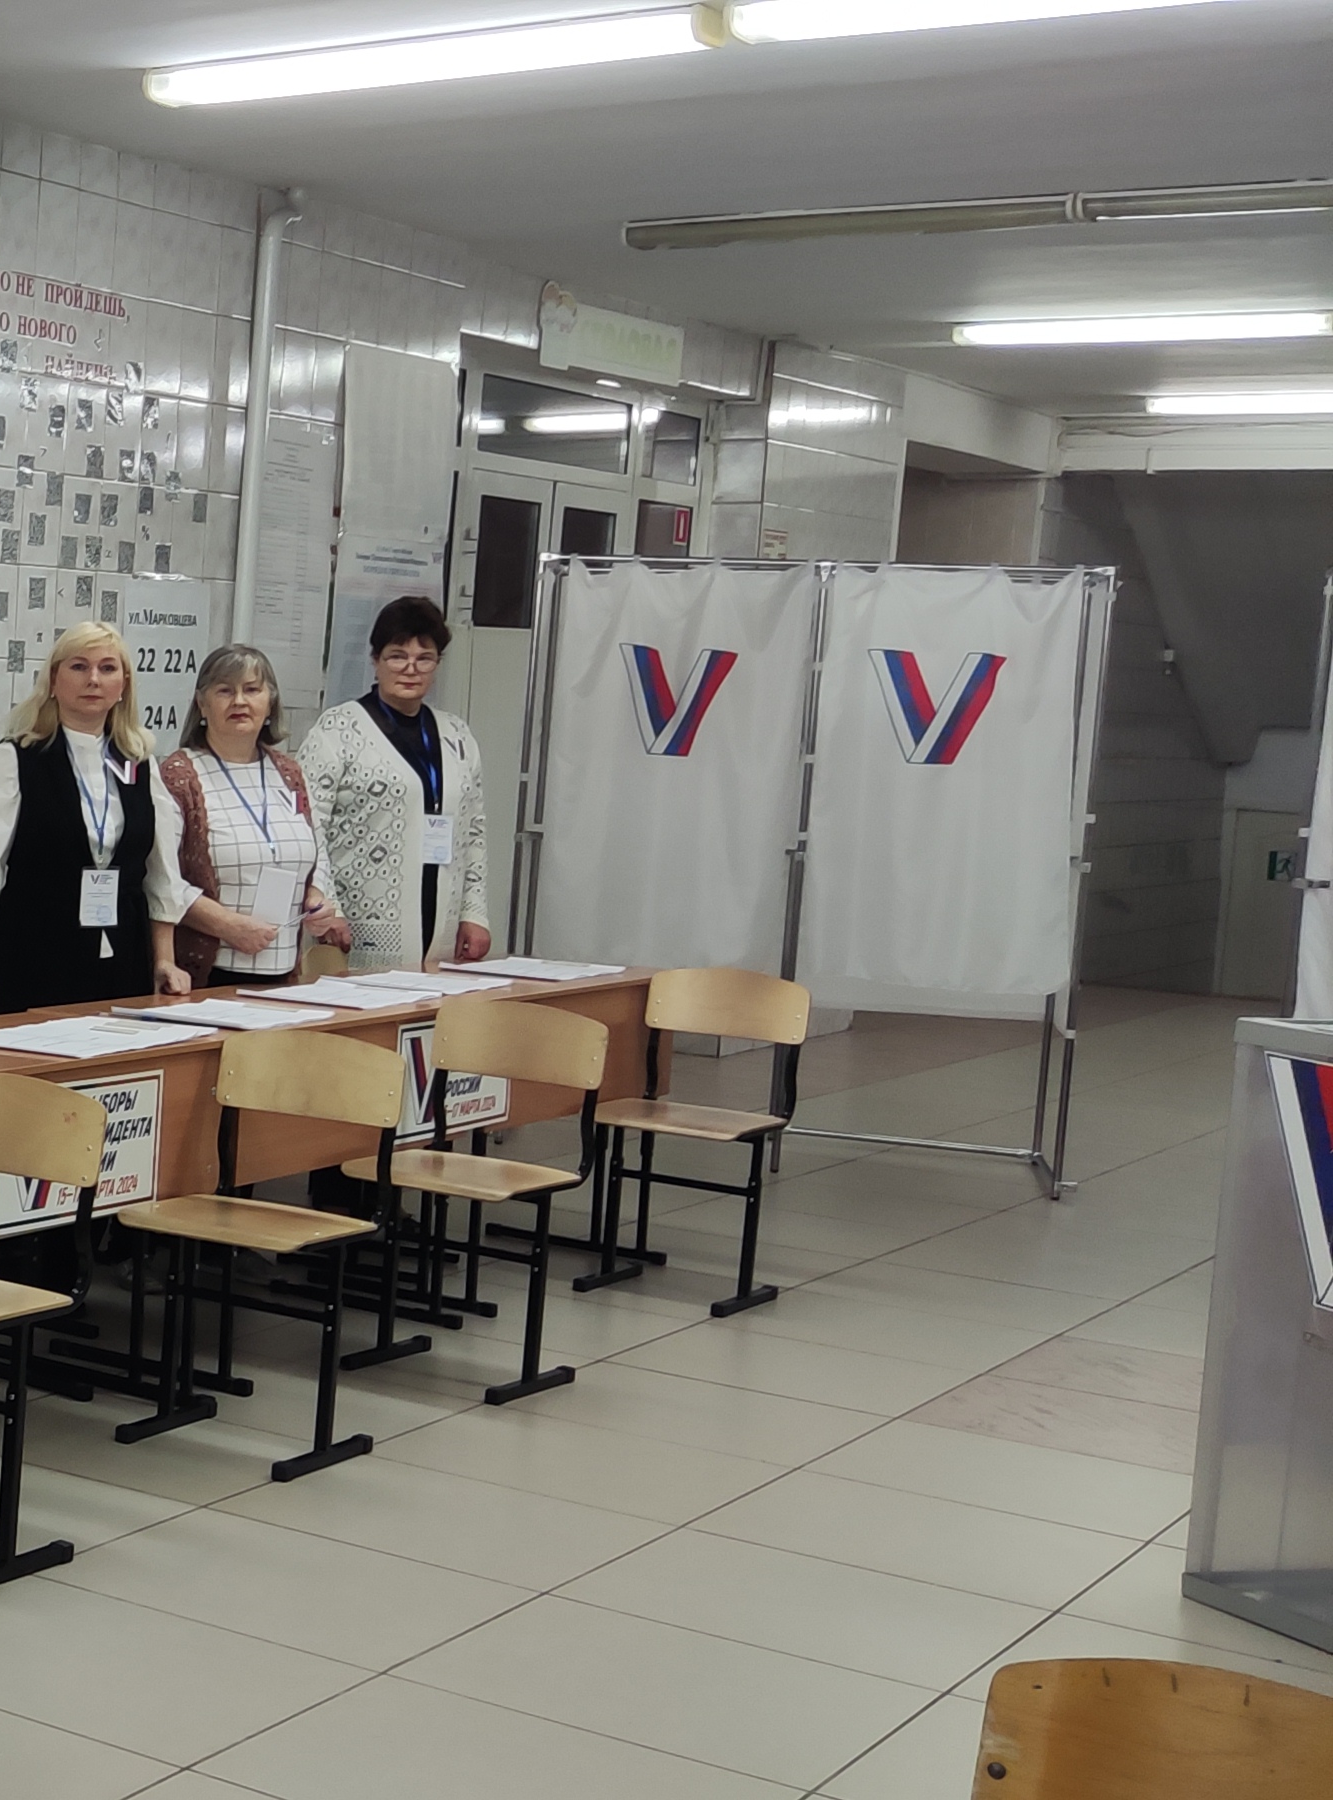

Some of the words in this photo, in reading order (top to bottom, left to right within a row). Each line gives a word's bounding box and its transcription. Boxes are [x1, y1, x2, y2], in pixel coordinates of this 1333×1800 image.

[16, 275, 36, 298] НЕ
[17, 315, 77, 345] НОВОГО
[137, 647, 155, 672] 22
[164, 648, 182, 673] 22
[144, 705, 163, 730] 24
[104, 1116, 153, 1145] ИДЕНТА
[116, 1174, 138, 1195] 2024
